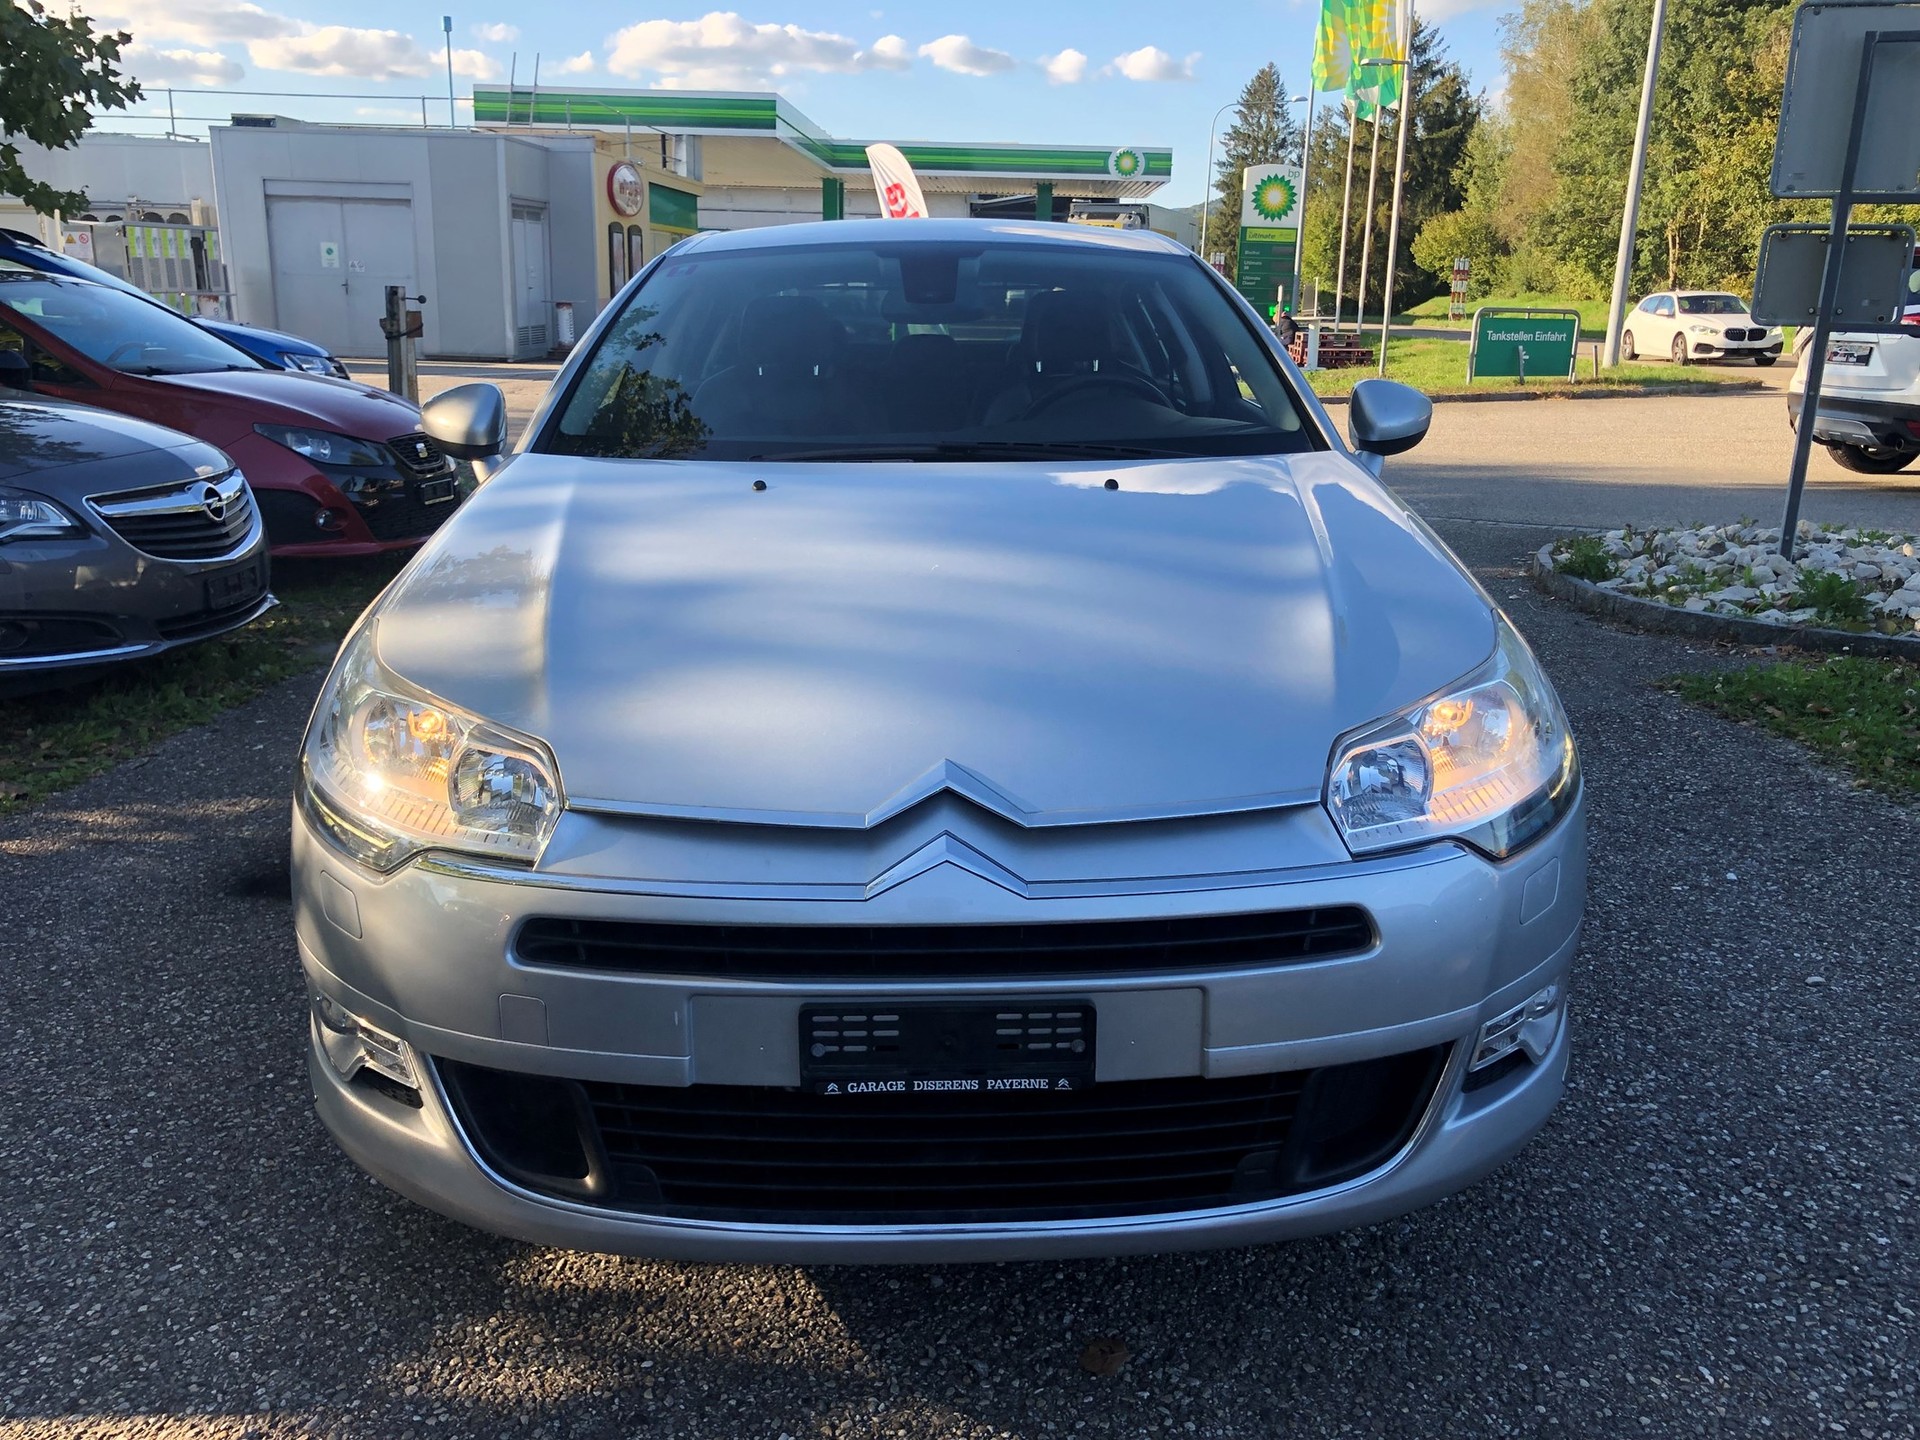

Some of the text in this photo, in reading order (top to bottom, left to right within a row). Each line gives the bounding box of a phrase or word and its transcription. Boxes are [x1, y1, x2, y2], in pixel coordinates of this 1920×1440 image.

[1287, 168, 1301, 178] bp
[1486, 330, 1567, 342] Tankstellen Einfahrt
[847, 1078, 1049, 1093] GARAGE DISERENS PAYERNE
